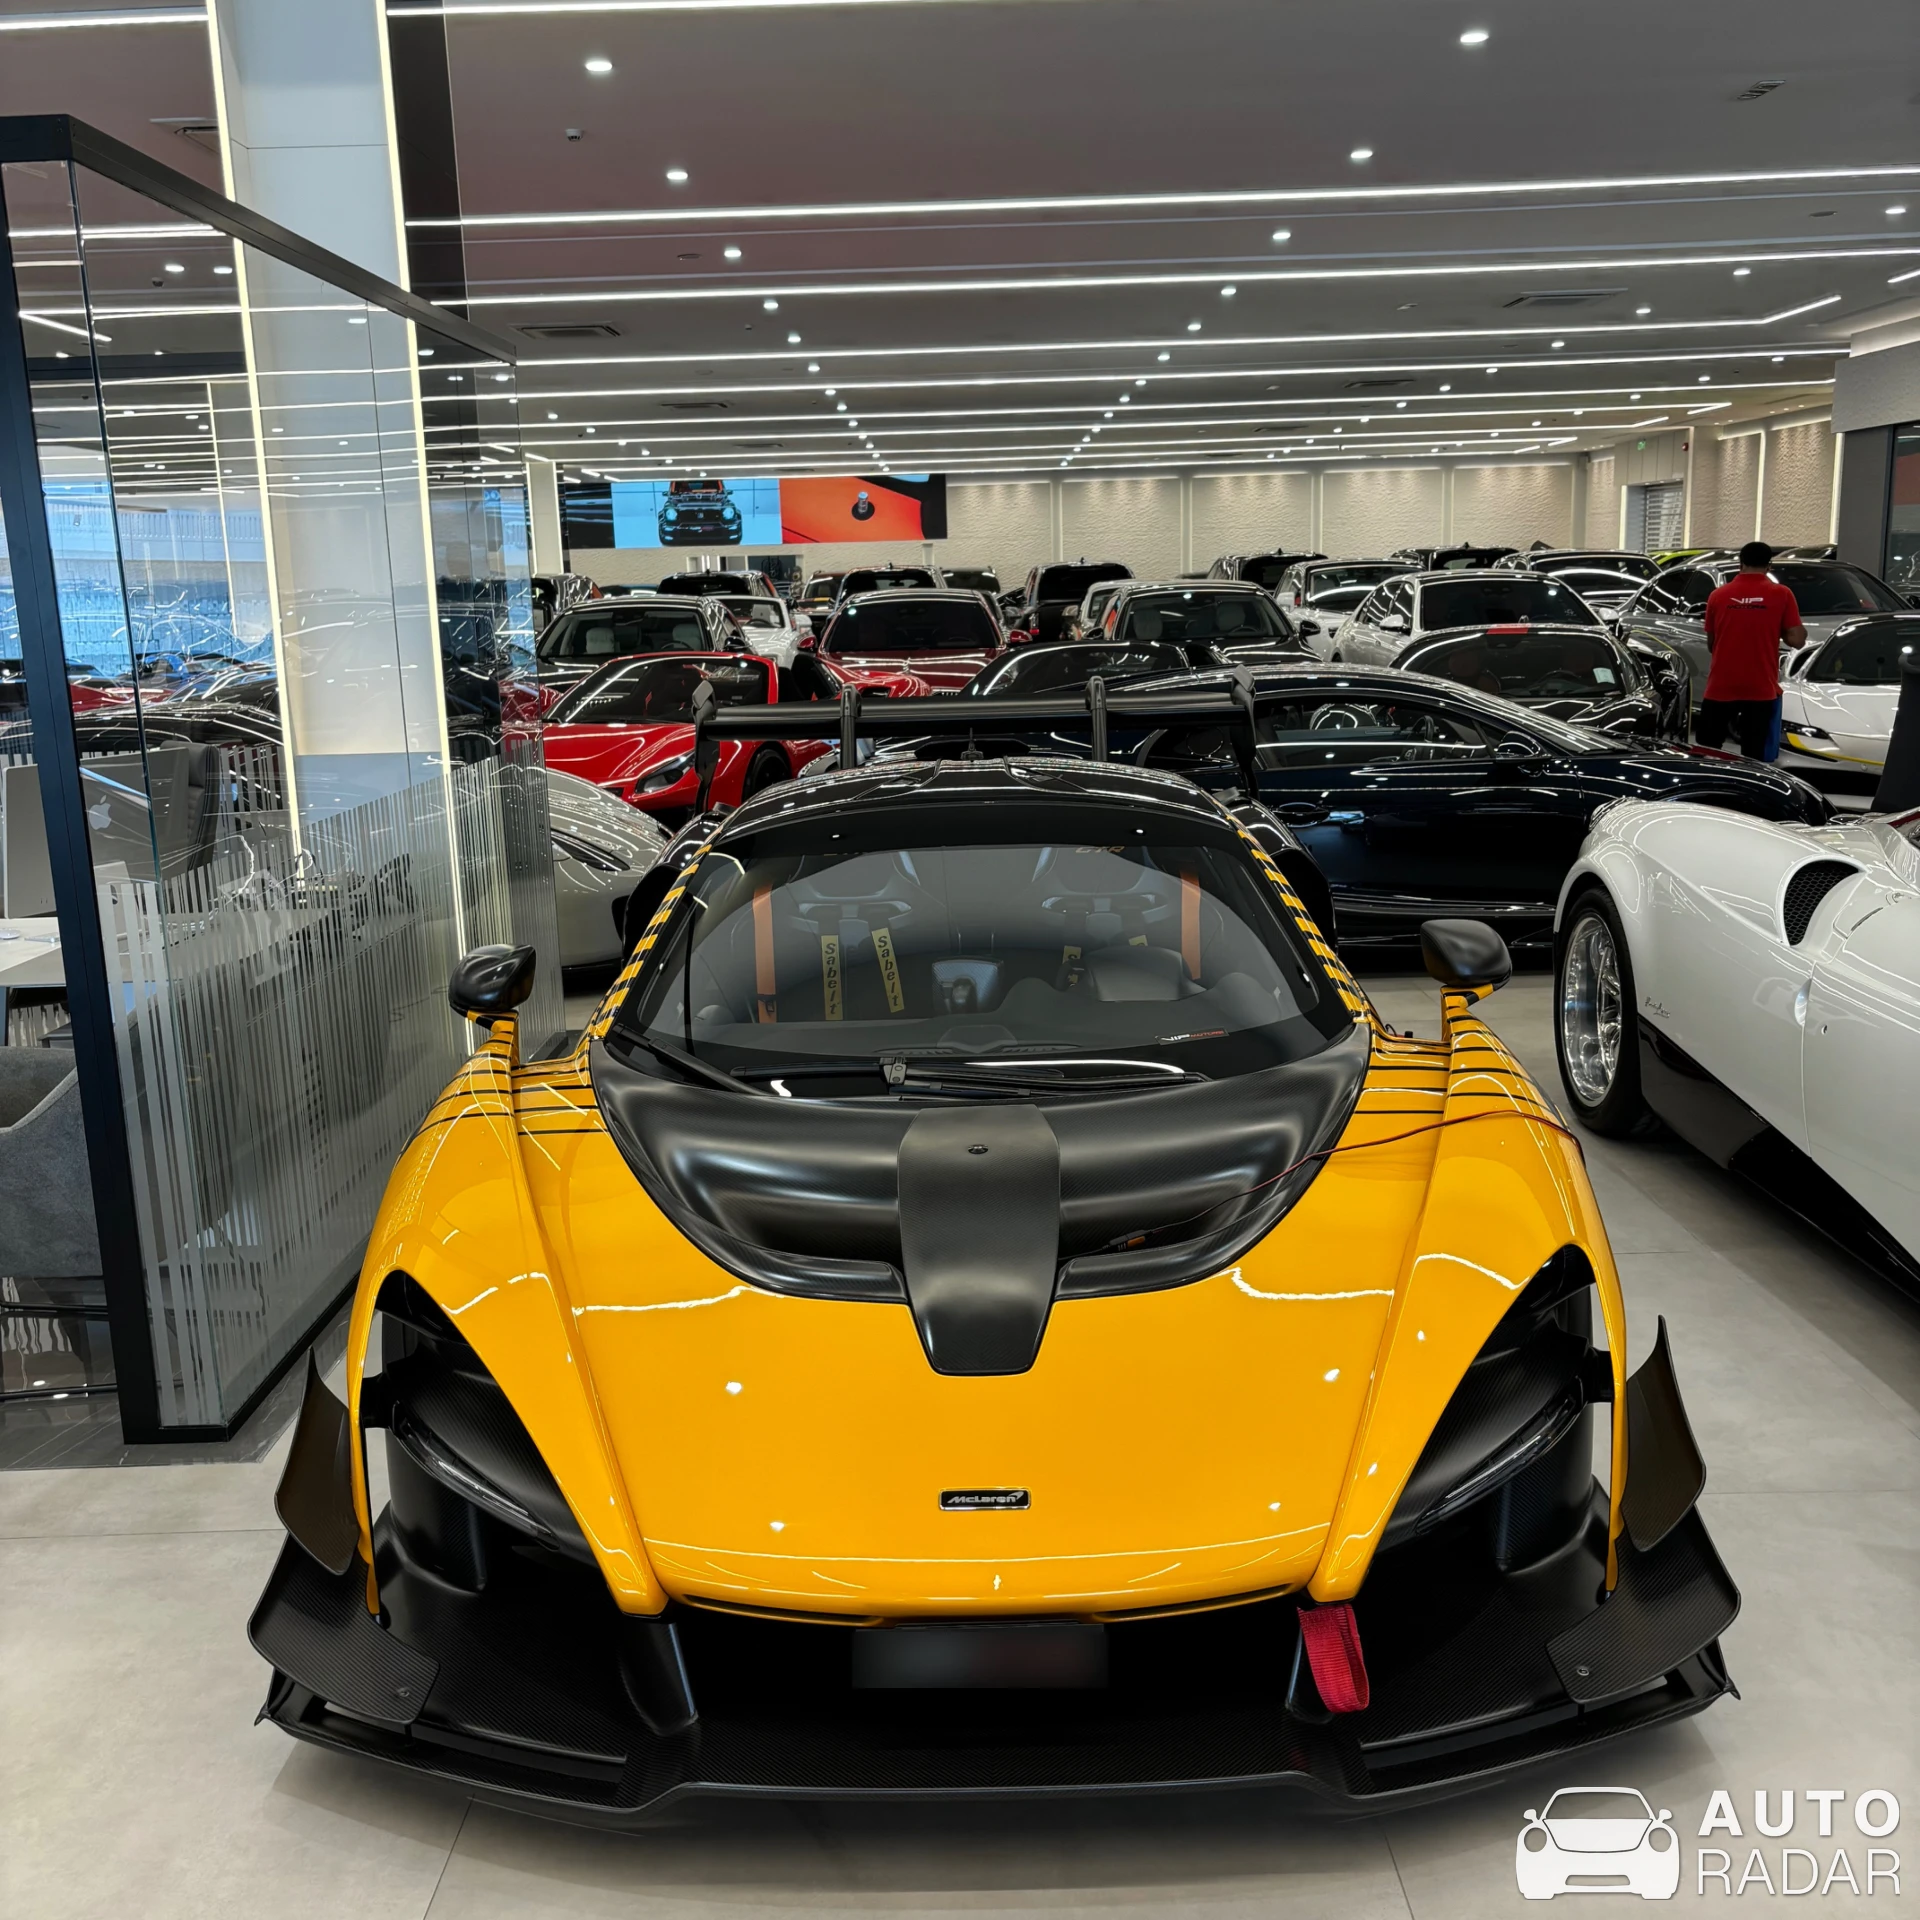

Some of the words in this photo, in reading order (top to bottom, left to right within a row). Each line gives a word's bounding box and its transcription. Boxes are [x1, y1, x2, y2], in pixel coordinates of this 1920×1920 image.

[824, 942, 839, 1015] Sabelt
[877, 935, 899, 1007] Sabelt
[1160, 1033, 1190, 1042] VIP
[947, 1494, 1019, 1504] McLaren
